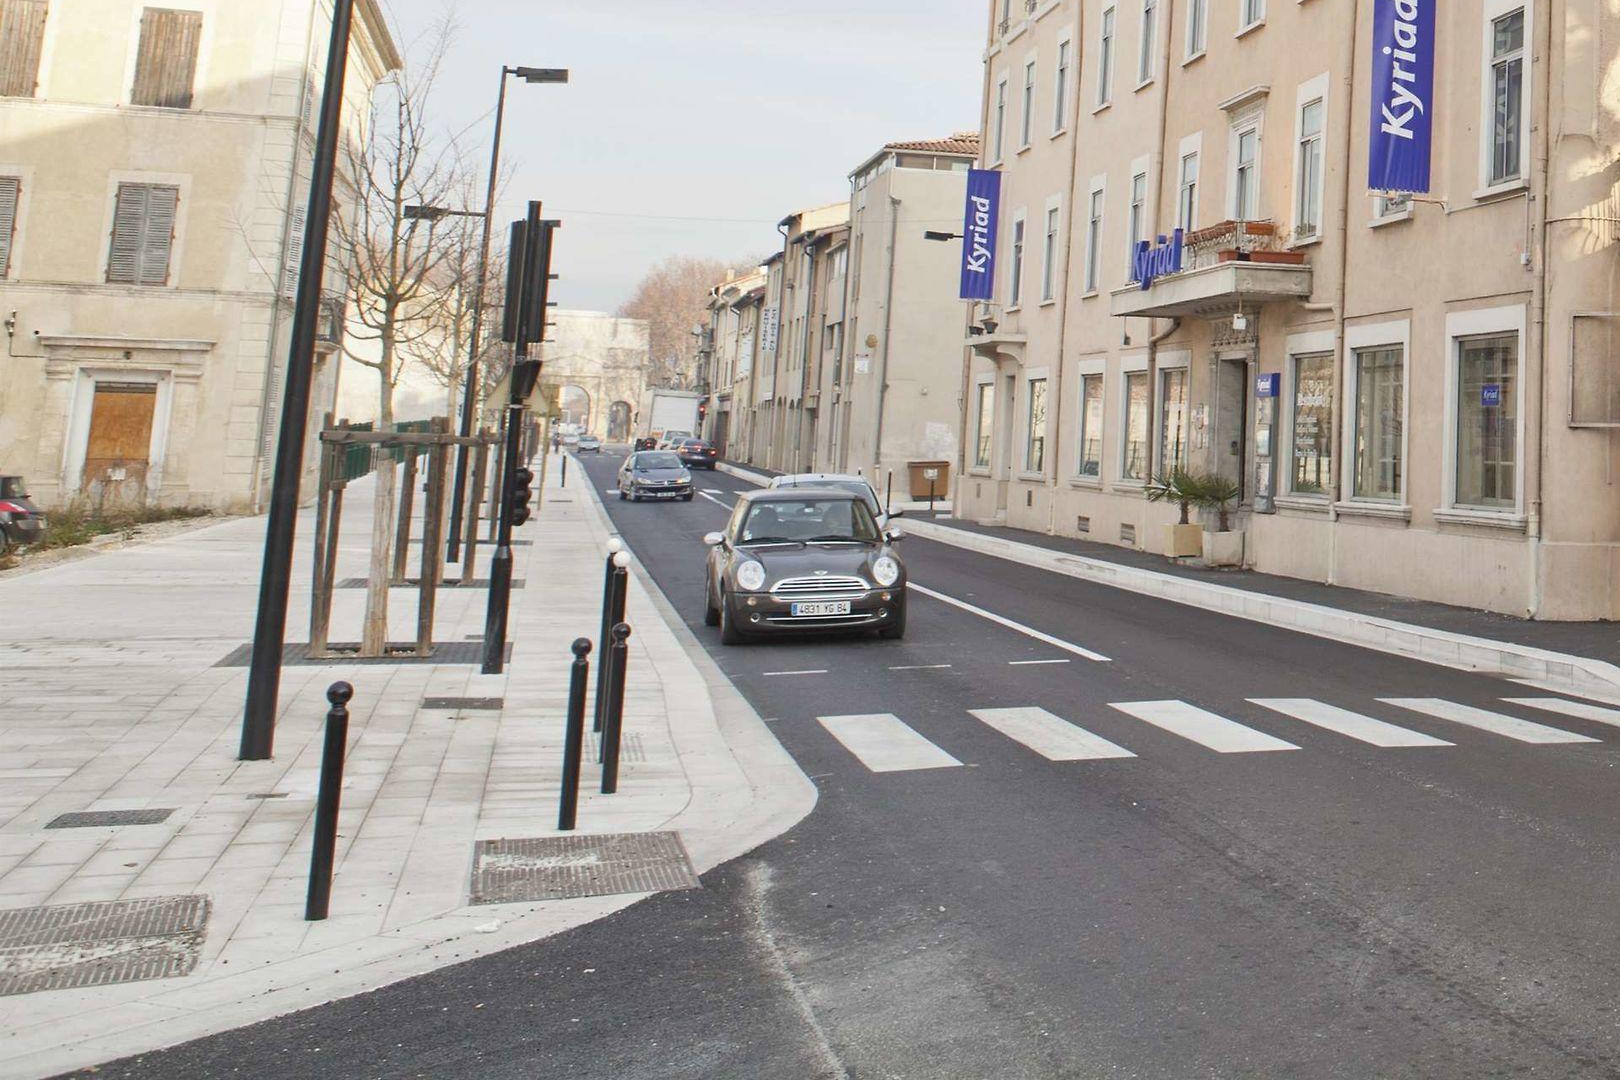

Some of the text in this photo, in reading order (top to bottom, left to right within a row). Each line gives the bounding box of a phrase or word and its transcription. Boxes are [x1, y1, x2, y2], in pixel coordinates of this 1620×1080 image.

[967, 195, 991, 273] Kyriad
[1130, 228, 1184, 291] Kyriad
[800, 604, 820, 614] 4831
[837, 603, 847, 613] 84
